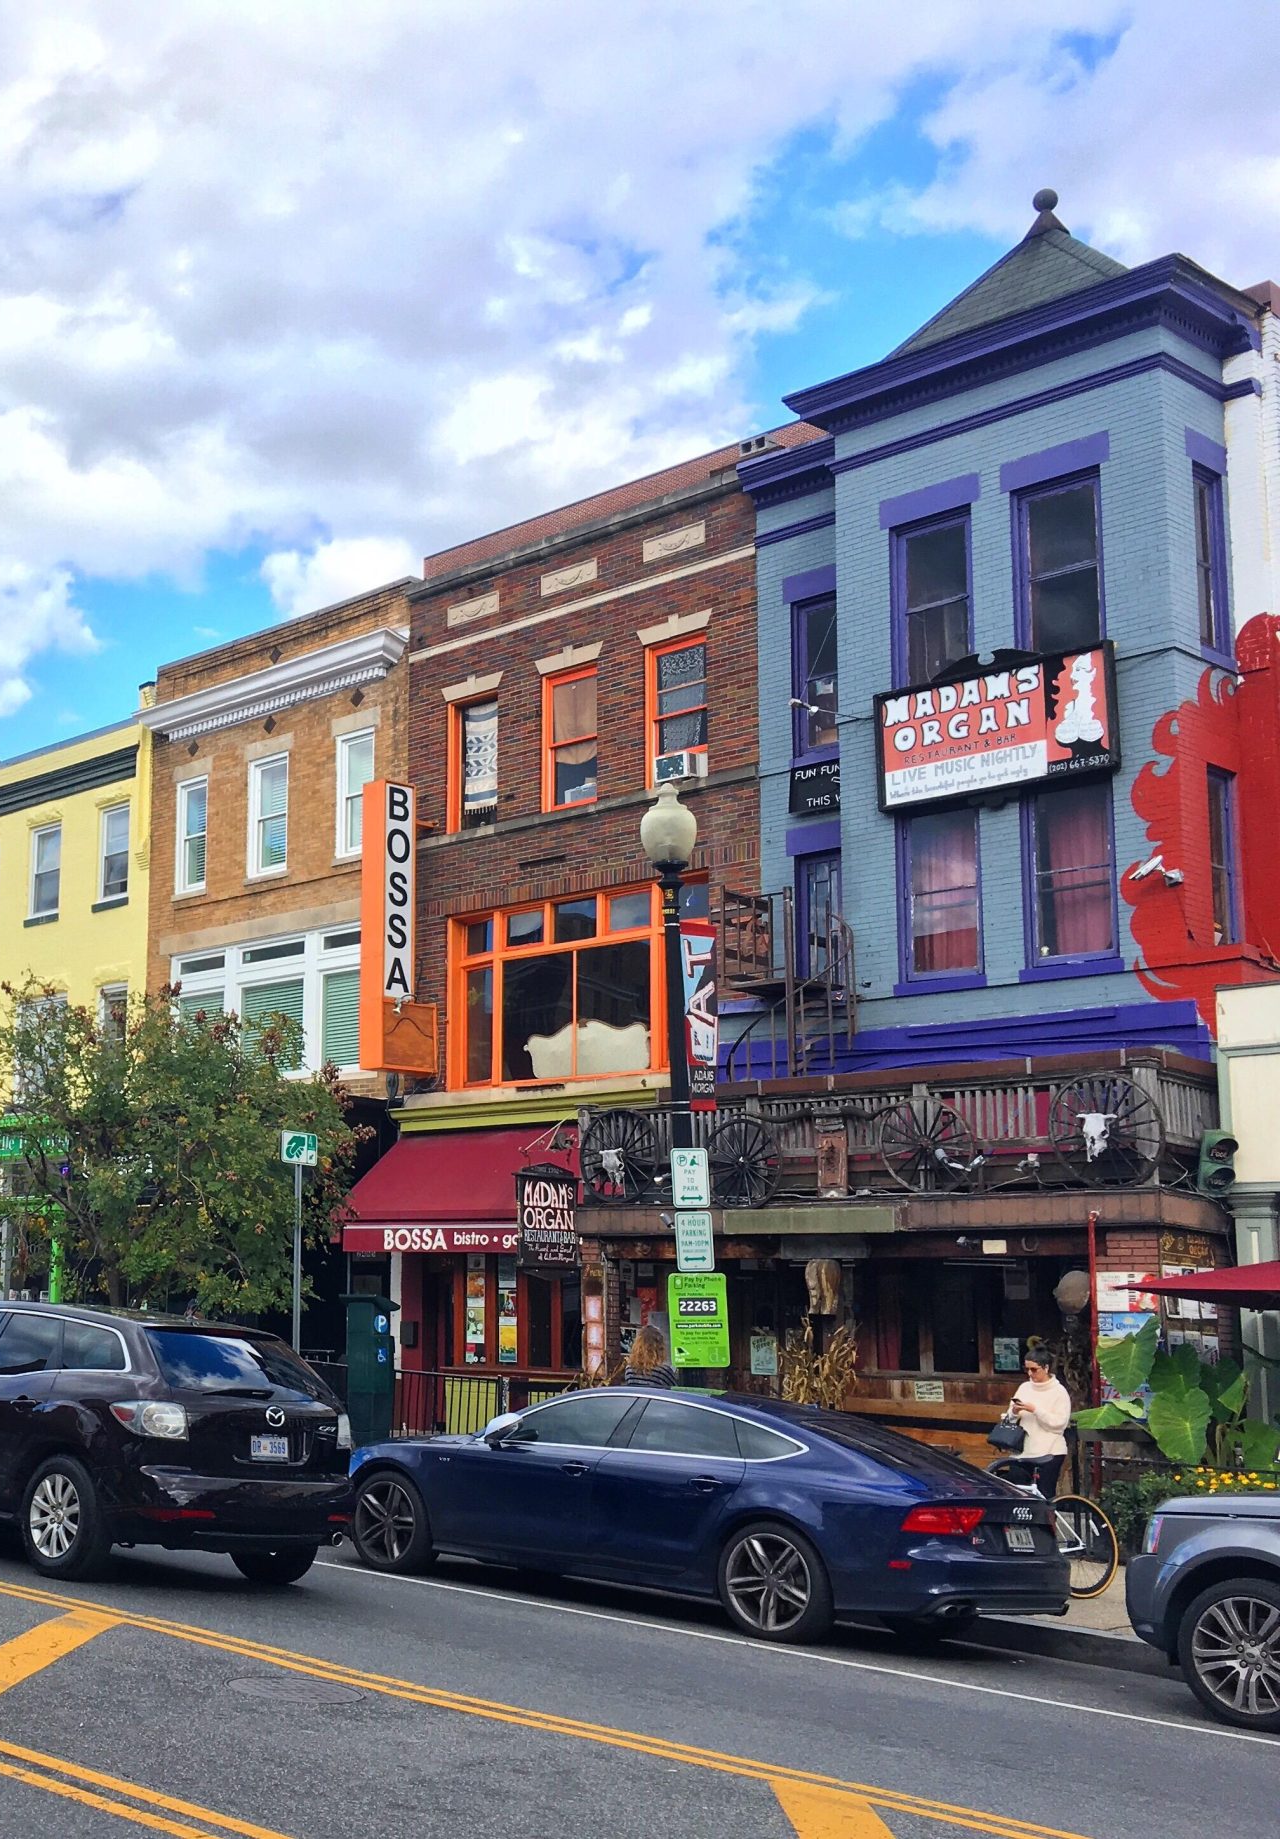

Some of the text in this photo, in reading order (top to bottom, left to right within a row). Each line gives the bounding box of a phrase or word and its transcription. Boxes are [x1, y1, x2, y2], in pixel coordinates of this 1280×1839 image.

[884, 664, 1041, 727] MADAM'S
[893, 698, 1031, 752] ORGAN
[904, 734, 1017, 764] RESTAURANT & BAR
[891, 744, 1038, 786] LIVE MUSIC NIGHTLY
[1049, 761, 1067, 774] (202)
[795, 768, 817, 781] FUN
[806, 794, 831, 807] THIS
[385, 785, 411, 994] BOSSA
[693, 1070, 715, 1081] ADAMS
[691, 1082, 715, 1093] MORGAN
[523, 1207, 575, 1231] ORGAN
[688, 1218, 706, 1226] HOUR
[383, 1228, 448, 1251] BOSSA
[453, 1231, 489, 1246] bistro
[682, 1229, 707, 1237] PARKING
[679, 1300, 717, 1312] 22263
[252, 1440, 262, 1453] DR
